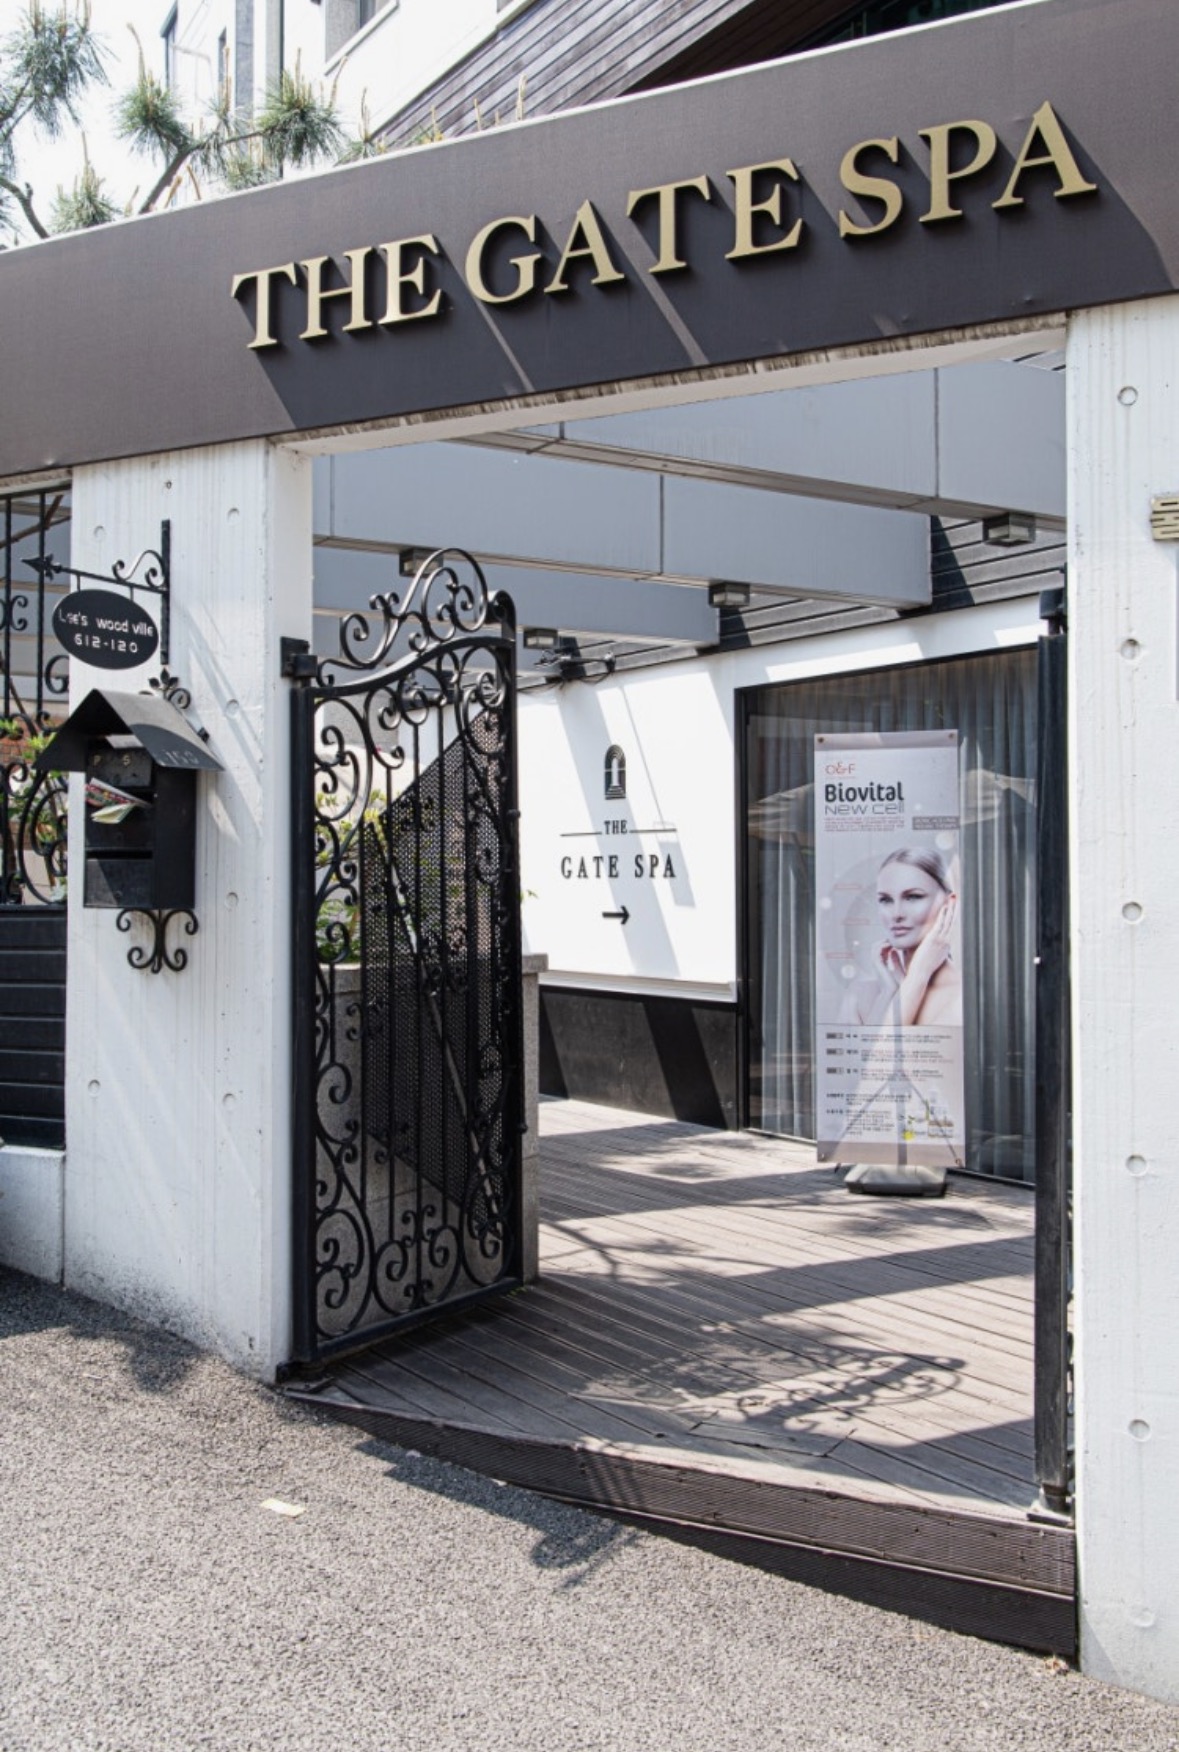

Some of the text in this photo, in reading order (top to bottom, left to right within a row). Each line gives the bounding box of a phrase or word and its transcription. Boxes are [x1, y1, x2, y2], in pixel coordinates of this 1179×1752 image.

[231, 99, 1099, 350] THE GATE SPA
[74, 632, 138, 653] 612-120
[824, 780, 905, 803] Biovital
[603, 819, 628, 836] THE
[560, 853, 677, 880] GATE SPA
